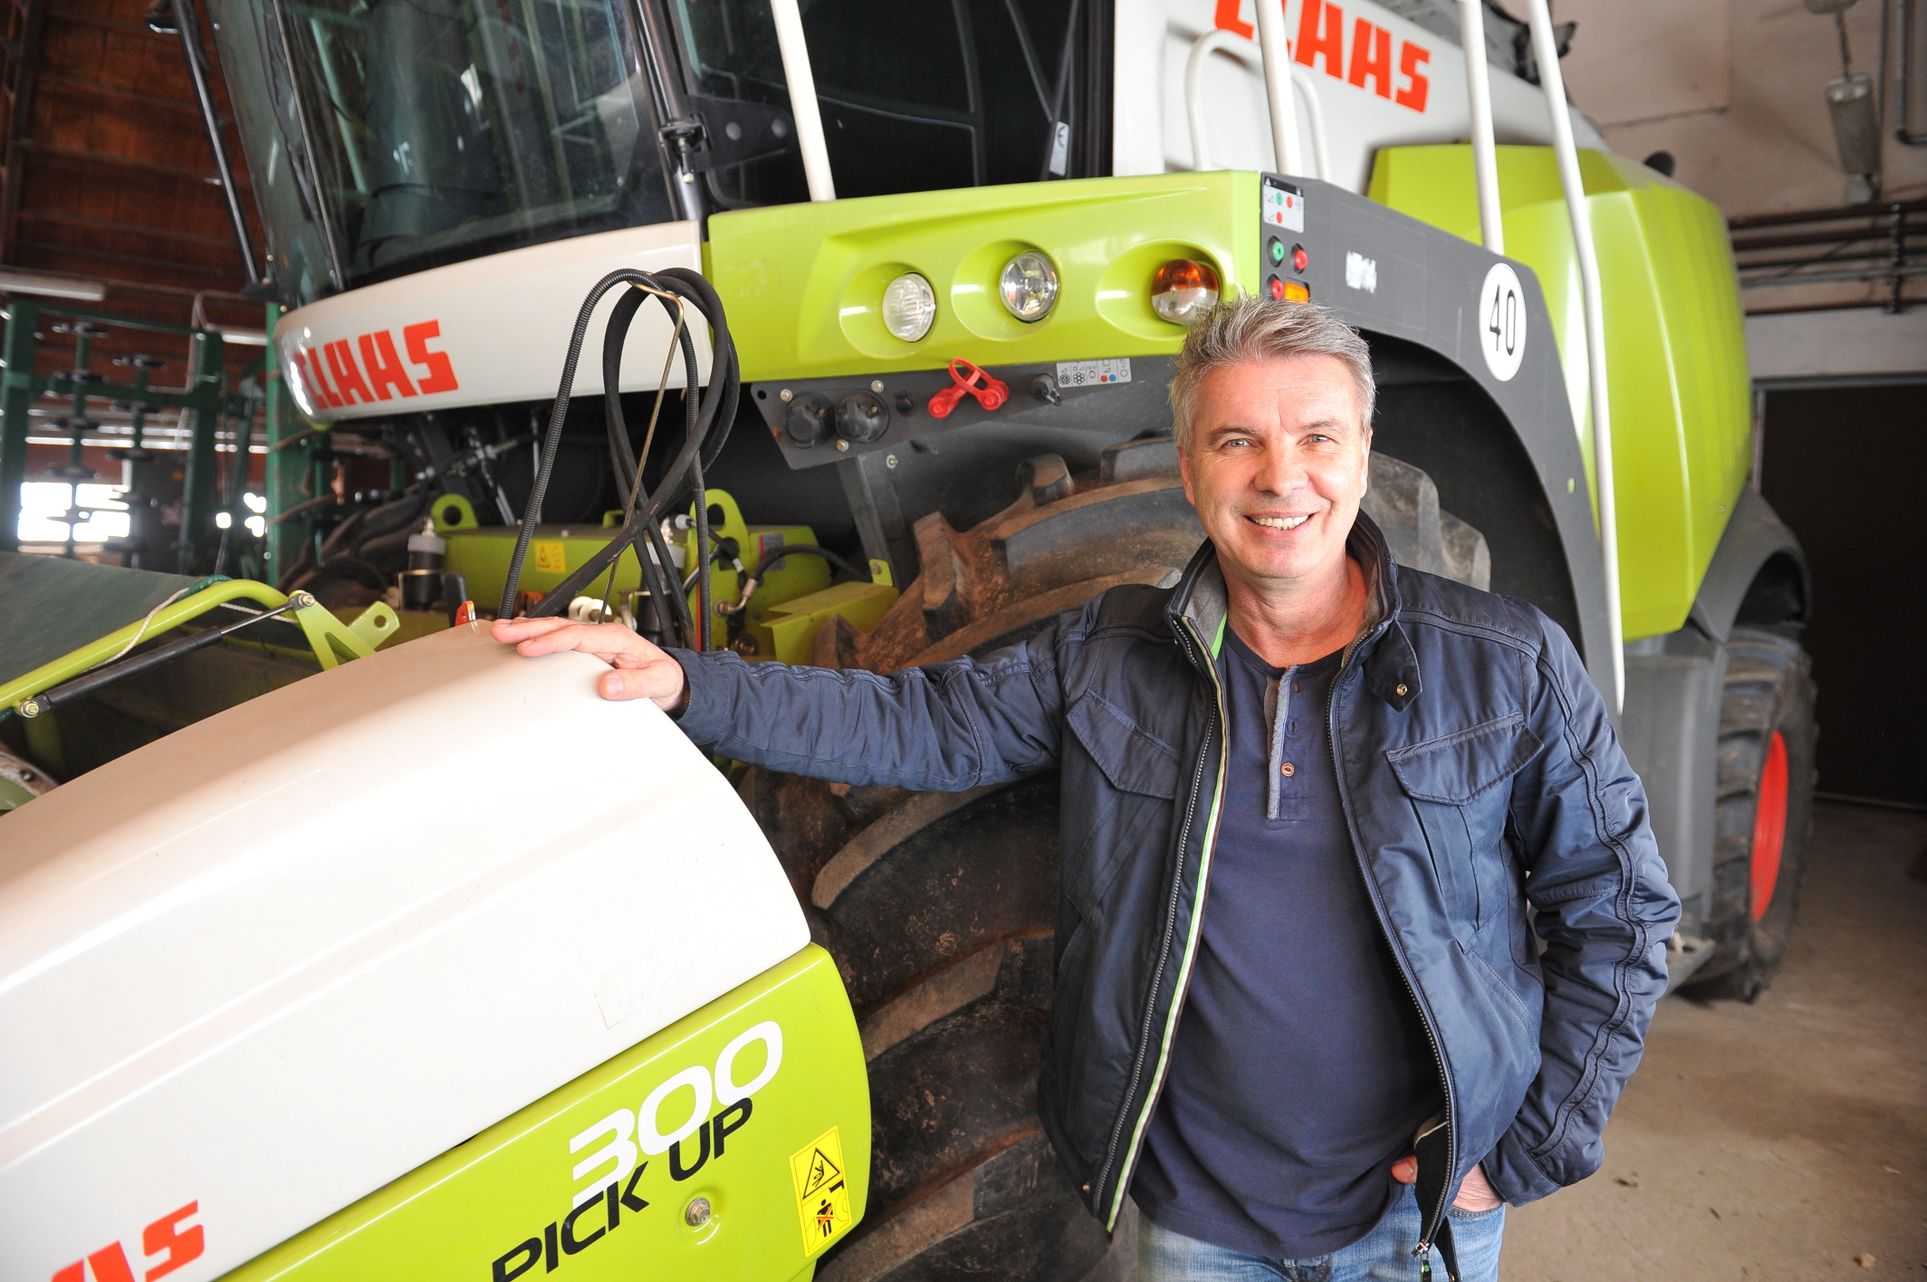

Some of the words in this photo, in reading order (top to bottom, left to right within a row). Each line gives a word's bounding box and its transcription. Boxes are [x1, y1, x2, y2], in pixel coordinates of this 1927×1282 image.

[1215, 0, 1431, 113] AAS
[1489, 283, 1517, 356] 40
[568, 1020, 783, 1209] 300
[492, 1160, 650, 1282] PICK
[668, 1097, 753, 1182] UP
